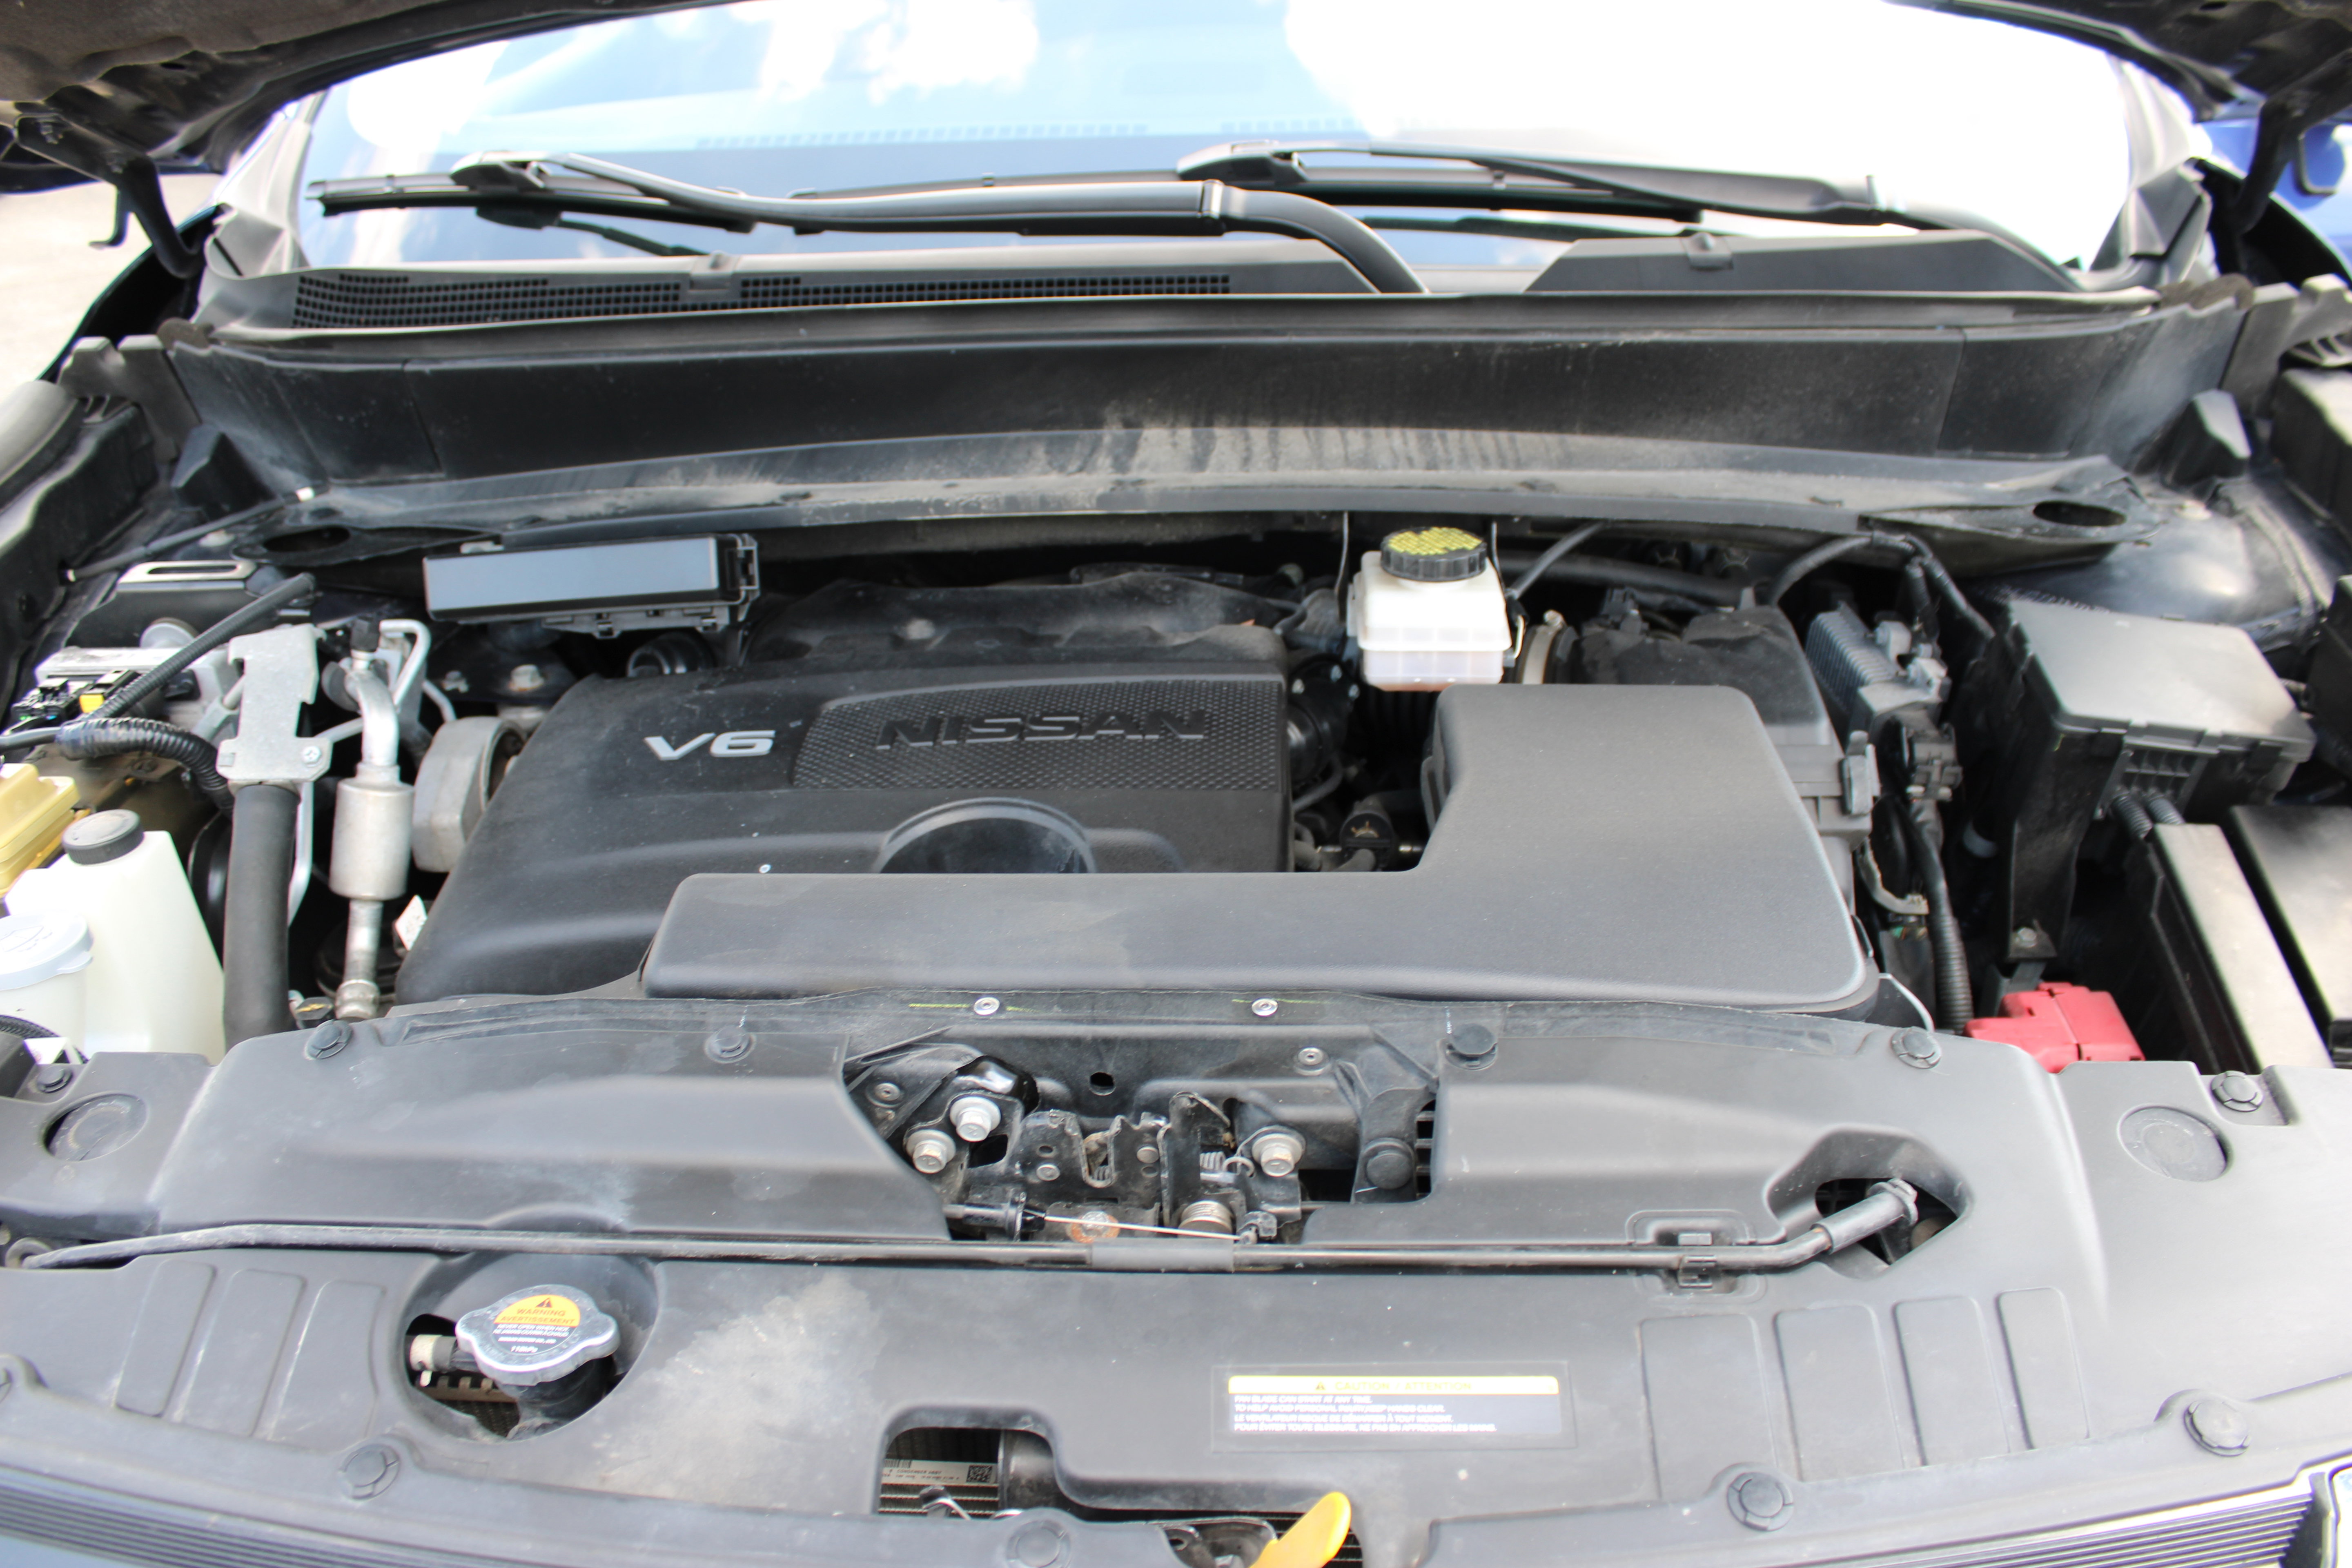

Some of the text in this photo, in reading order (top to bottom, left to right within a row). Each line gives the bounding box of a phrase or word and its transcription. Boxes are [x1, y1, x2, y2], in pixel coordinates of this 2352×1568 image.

[875, 708, 1207, 750] NISSAN
[643, 729, 775, 761] V6
[517, 1309, 566, 1317] WARNING
[500, 1316, 575, 1325] AVERTISSEMENT
[1334, 1381, 1390, 1391] CAUTION
[1405, 1382, 1472, 1391] ATTENTION
[1235, 1395, 1373, 1404] FAN BLADE CAN START AT ANY TIME.
[1235, 1404, 1246, 1412] TO
[1247, 1404, 1269, 1412] HELP
[1269, 1404, 1294, 1412] AVOID
[1295, 1404, 1338, 1413] PERSONAL
[1387, 1405, 1416, 1413] HANDS
[1235, 1414, 1246, 1423] LE
[1246, 1414, 1297, 1423] VENTILATEUR
[1298, 1414, 1329, 1423] RISQUE
[1329, 1414, 1342, 1423] DE
[1342, 1413, 1387, 1423] DÉMARRER
[1394, 1414, 1416, 1423] TOUT
[1235, 1423, 1258, 1432] POUR
[1259, 1421, 1287, 1432] ÉVITER
[1287, 1423, 1314, 1432] TOUTE
[1359, 1423, 1372, 1432] NE
[1372, 1423, 1388, 1432] PAS
[1388, 1424, 1401, 1432] EN
[1401, 1423, 1452, 1432] APPROCHER
[1452, 1424, 1469, 1432] LES
